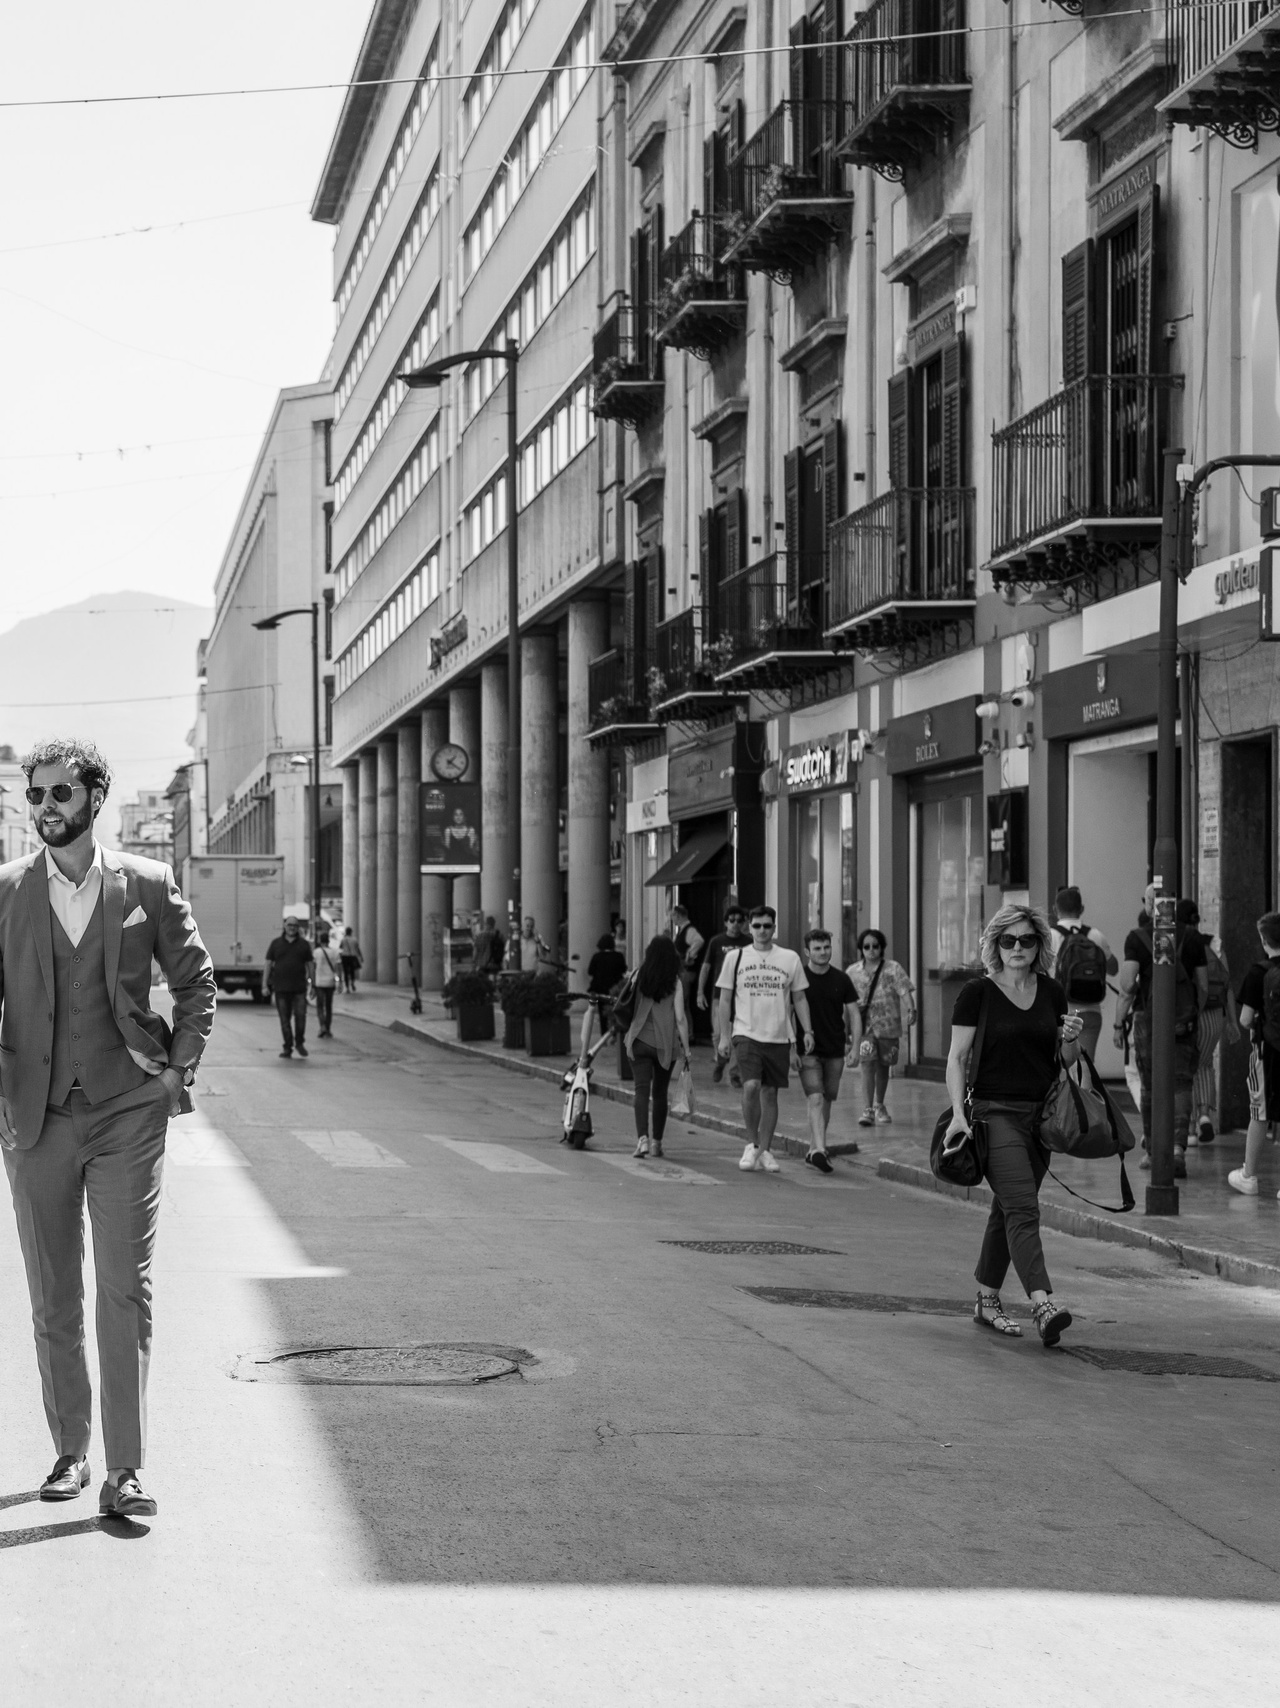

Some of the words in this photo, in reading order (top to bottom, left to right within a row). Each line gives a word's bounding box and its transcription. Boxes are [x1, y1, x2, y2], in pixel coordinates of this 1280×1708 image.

[1100, 165, 1151, 217] MATRANGA
[1082, 697, 1120, 723] MATRANGA
[786, 744, 824, 785] swatch
[915, 741, 939, 763] ROLEX
